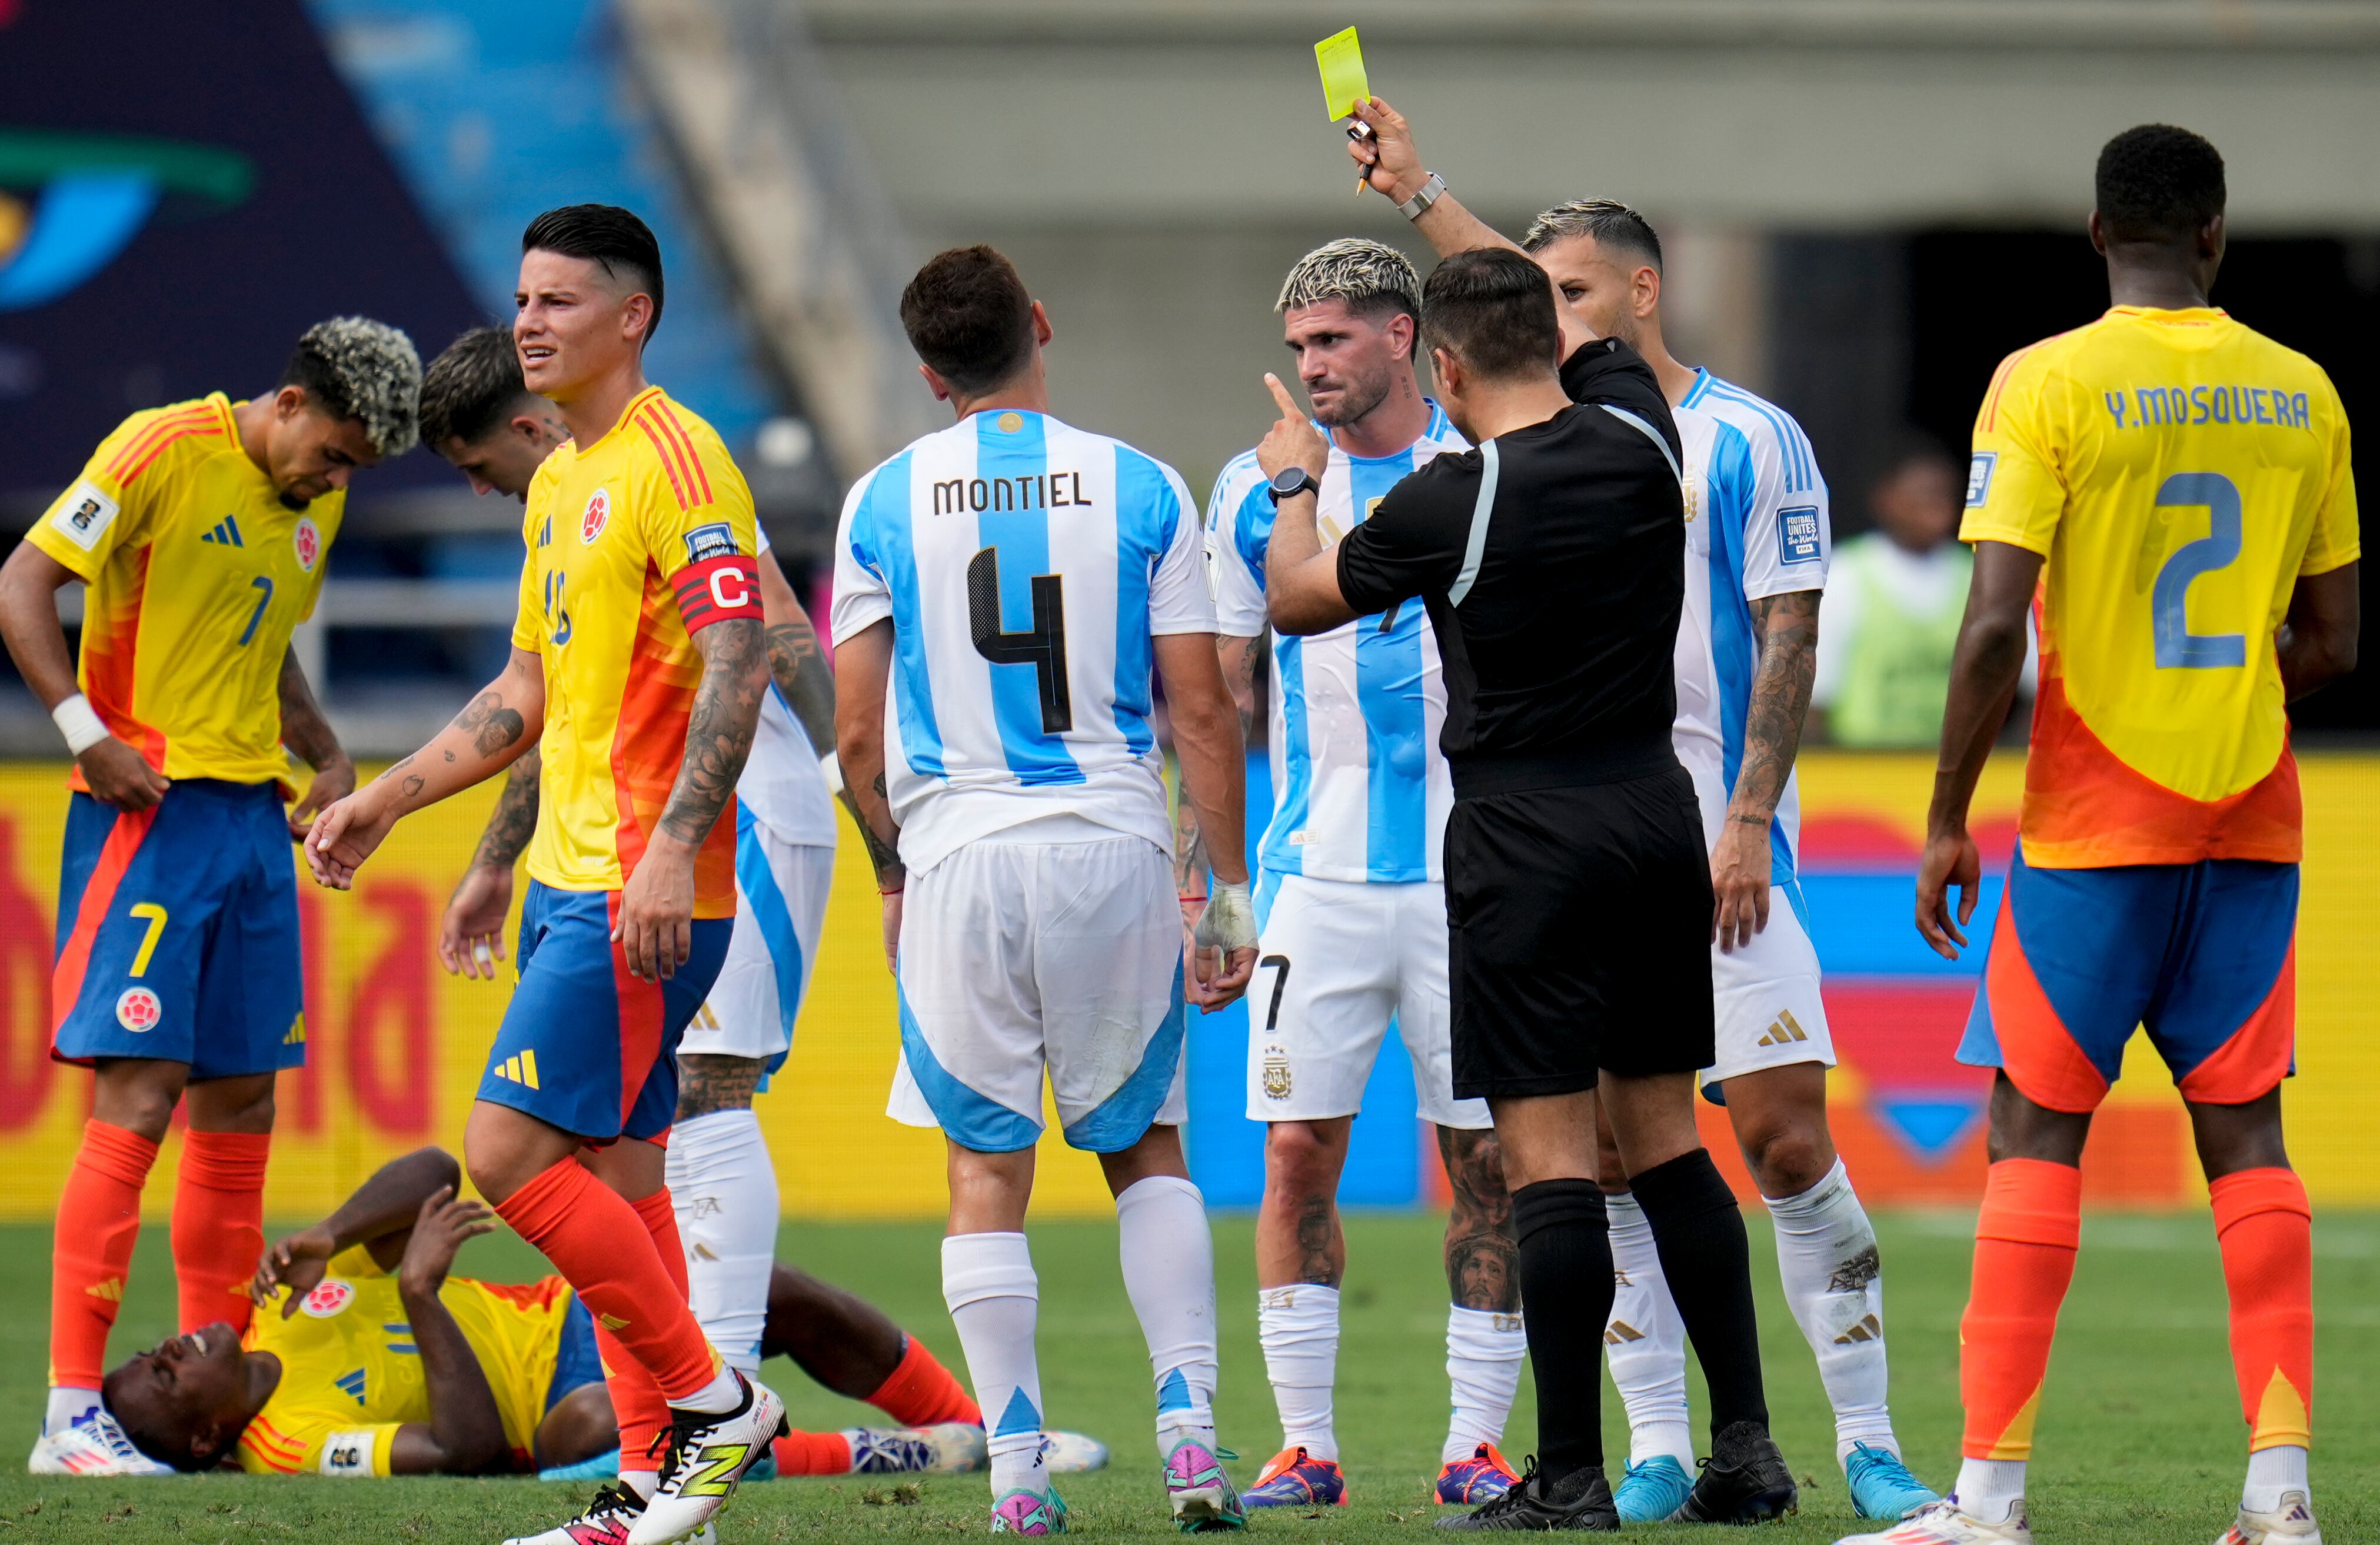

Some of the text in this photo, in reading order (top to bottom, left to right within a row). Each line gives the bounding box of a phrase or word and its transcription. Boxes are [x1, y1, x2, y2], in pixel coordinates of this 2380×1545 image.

[2105, 385, 2310, 429] Y.MOSQUERA
[934, 472, 1092, 515] MONTIEL
[695, 531, 725, 546] FOOTBALL
[1786, 514, 1815, 525] FOOTBALL
[1787, 533, 1819, 545] the World
[1788, 522, 1816, 536] UNITES
[710, 567, 749, 608] C
[2151, 471, 2246, 669] 2
[238, 575, 274, 647] 7
[966, 545, 1074, 735] 4
[129, 902, 168, 978] 7
[1260, 954, 1291, 1031] 7
